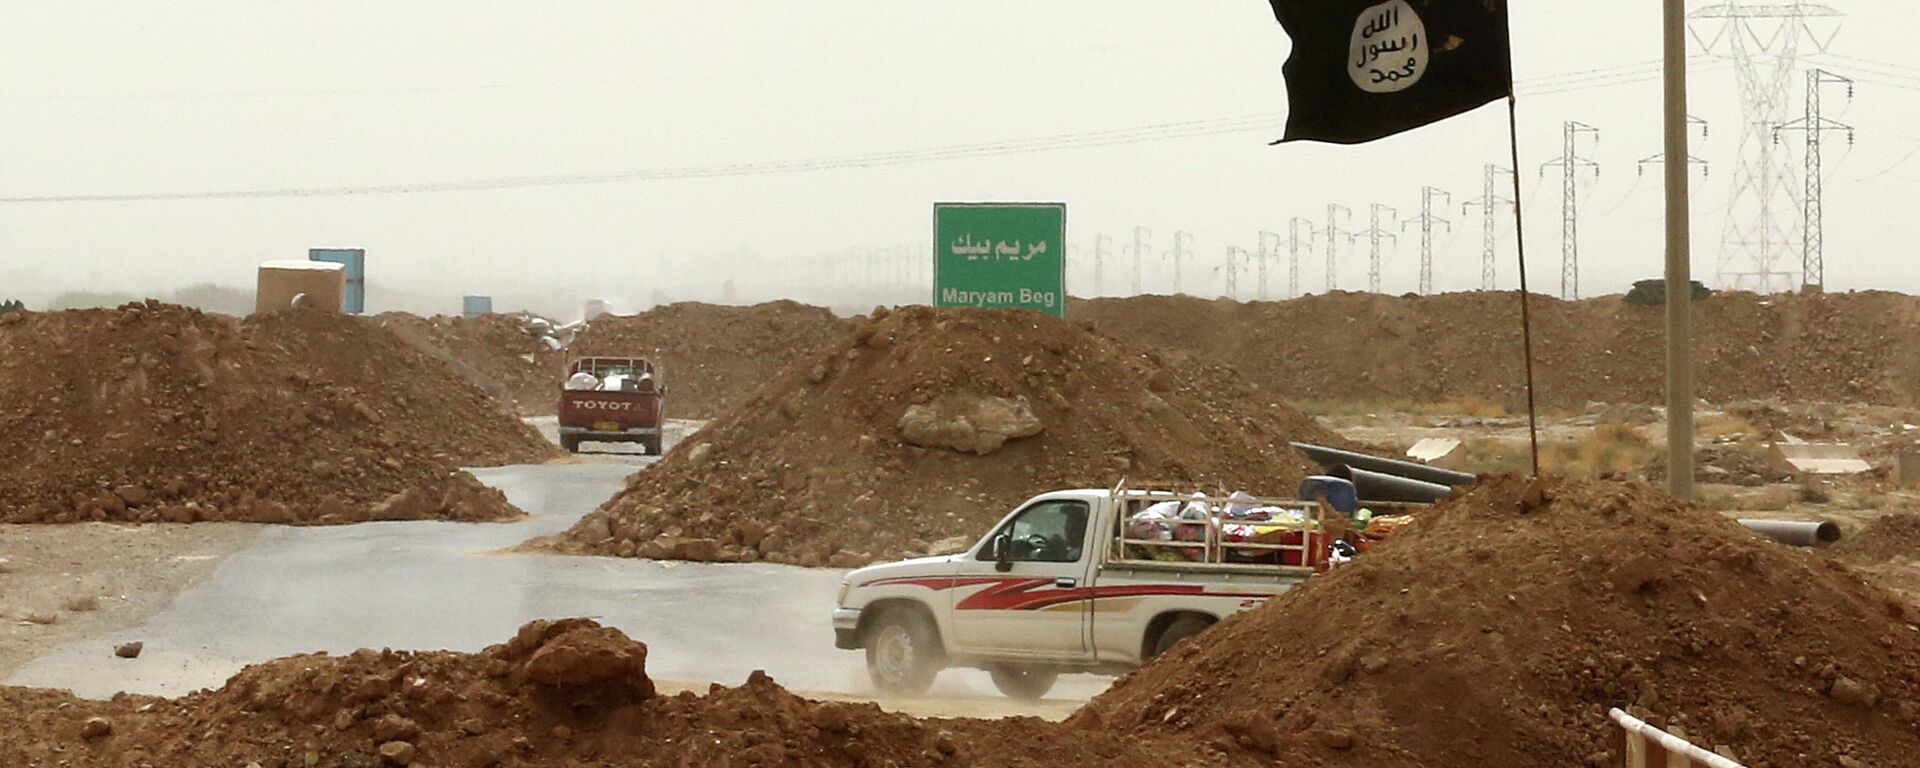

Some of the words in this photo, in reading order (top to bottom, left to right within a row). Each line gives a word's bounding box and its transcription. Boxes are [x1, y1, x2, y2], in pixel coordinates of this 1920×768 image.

[1363, 6, 1398, 38] الله
[1357, 33, 1417, 68] رسول
[1370, 57, 1416, 83] محمد
[995, 239, 1046, 261] مريم
[943, 287, 1013, 307] Maryam
[1020, 288, 1055, 307] Beg
